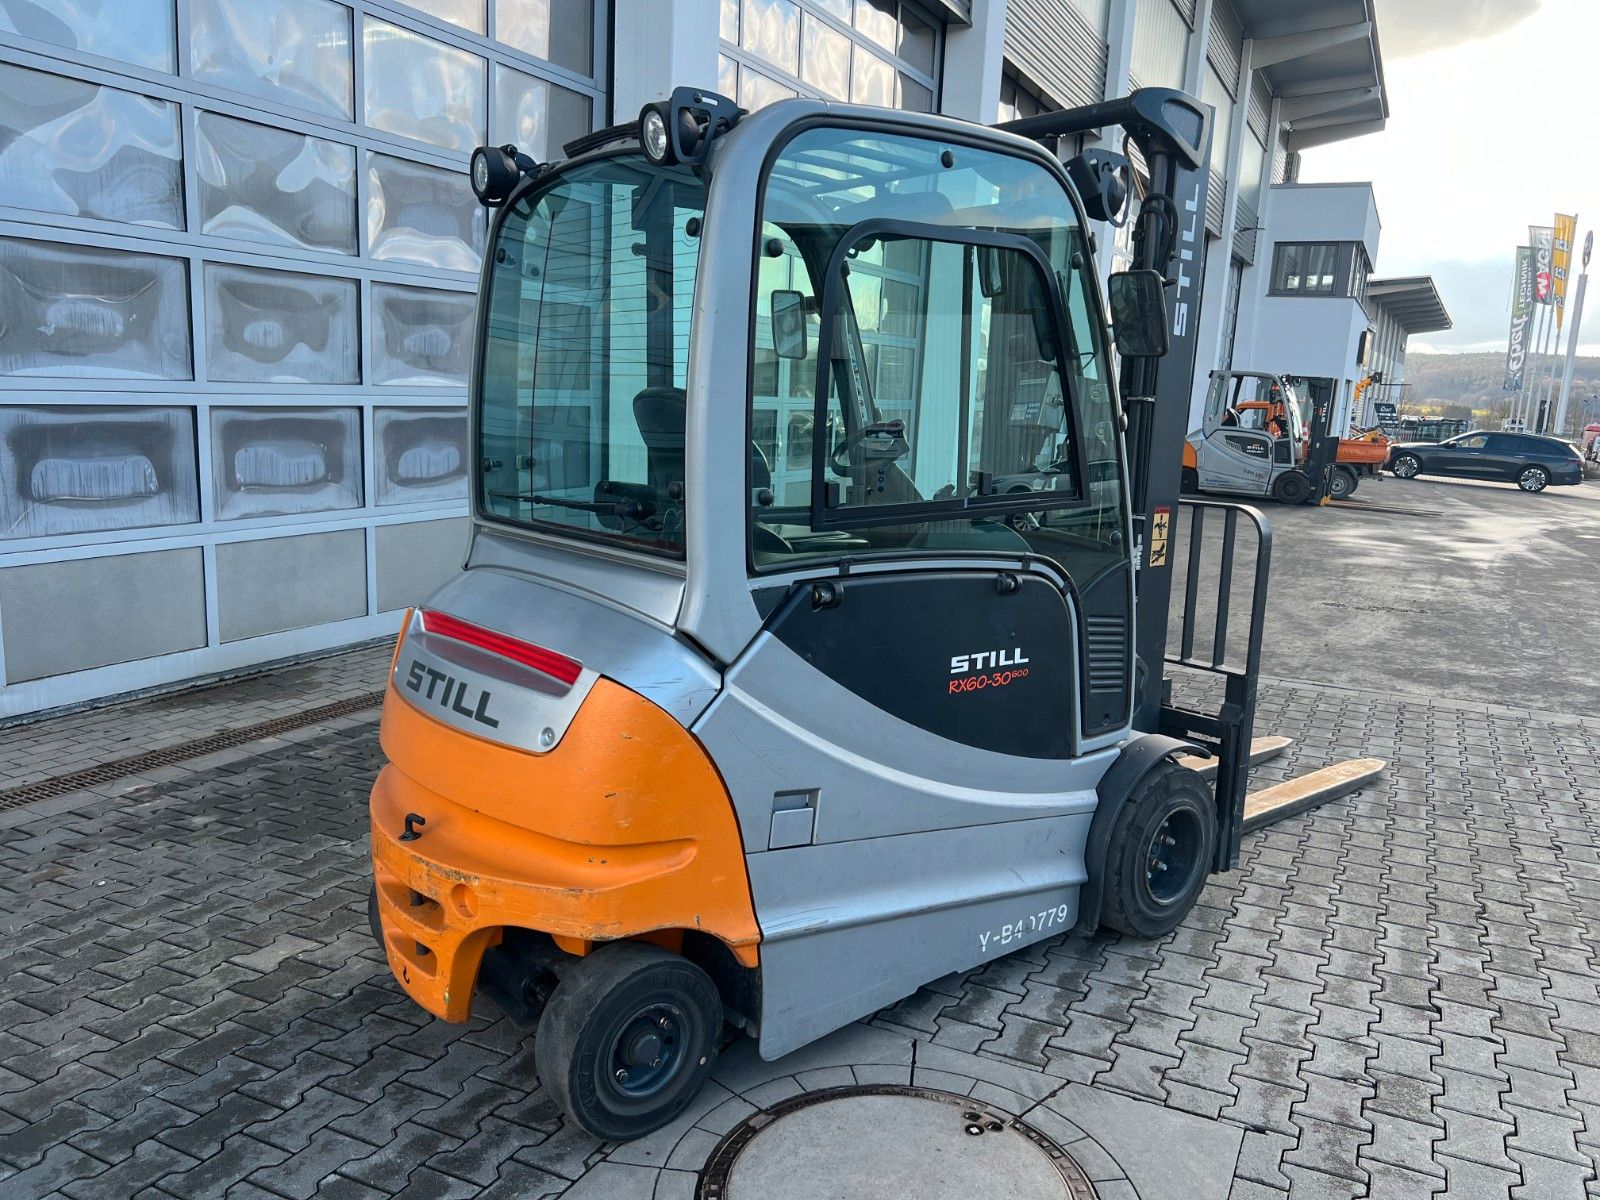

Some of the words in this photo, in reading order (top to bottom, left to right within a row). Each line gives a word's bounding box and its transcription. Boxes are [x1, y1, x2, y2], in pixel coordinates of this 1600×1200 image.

[1173, 183, 1199, 337] STILL
[406, 660, 499, 729] STILL
[951, 647, 1029, 674] STILL
